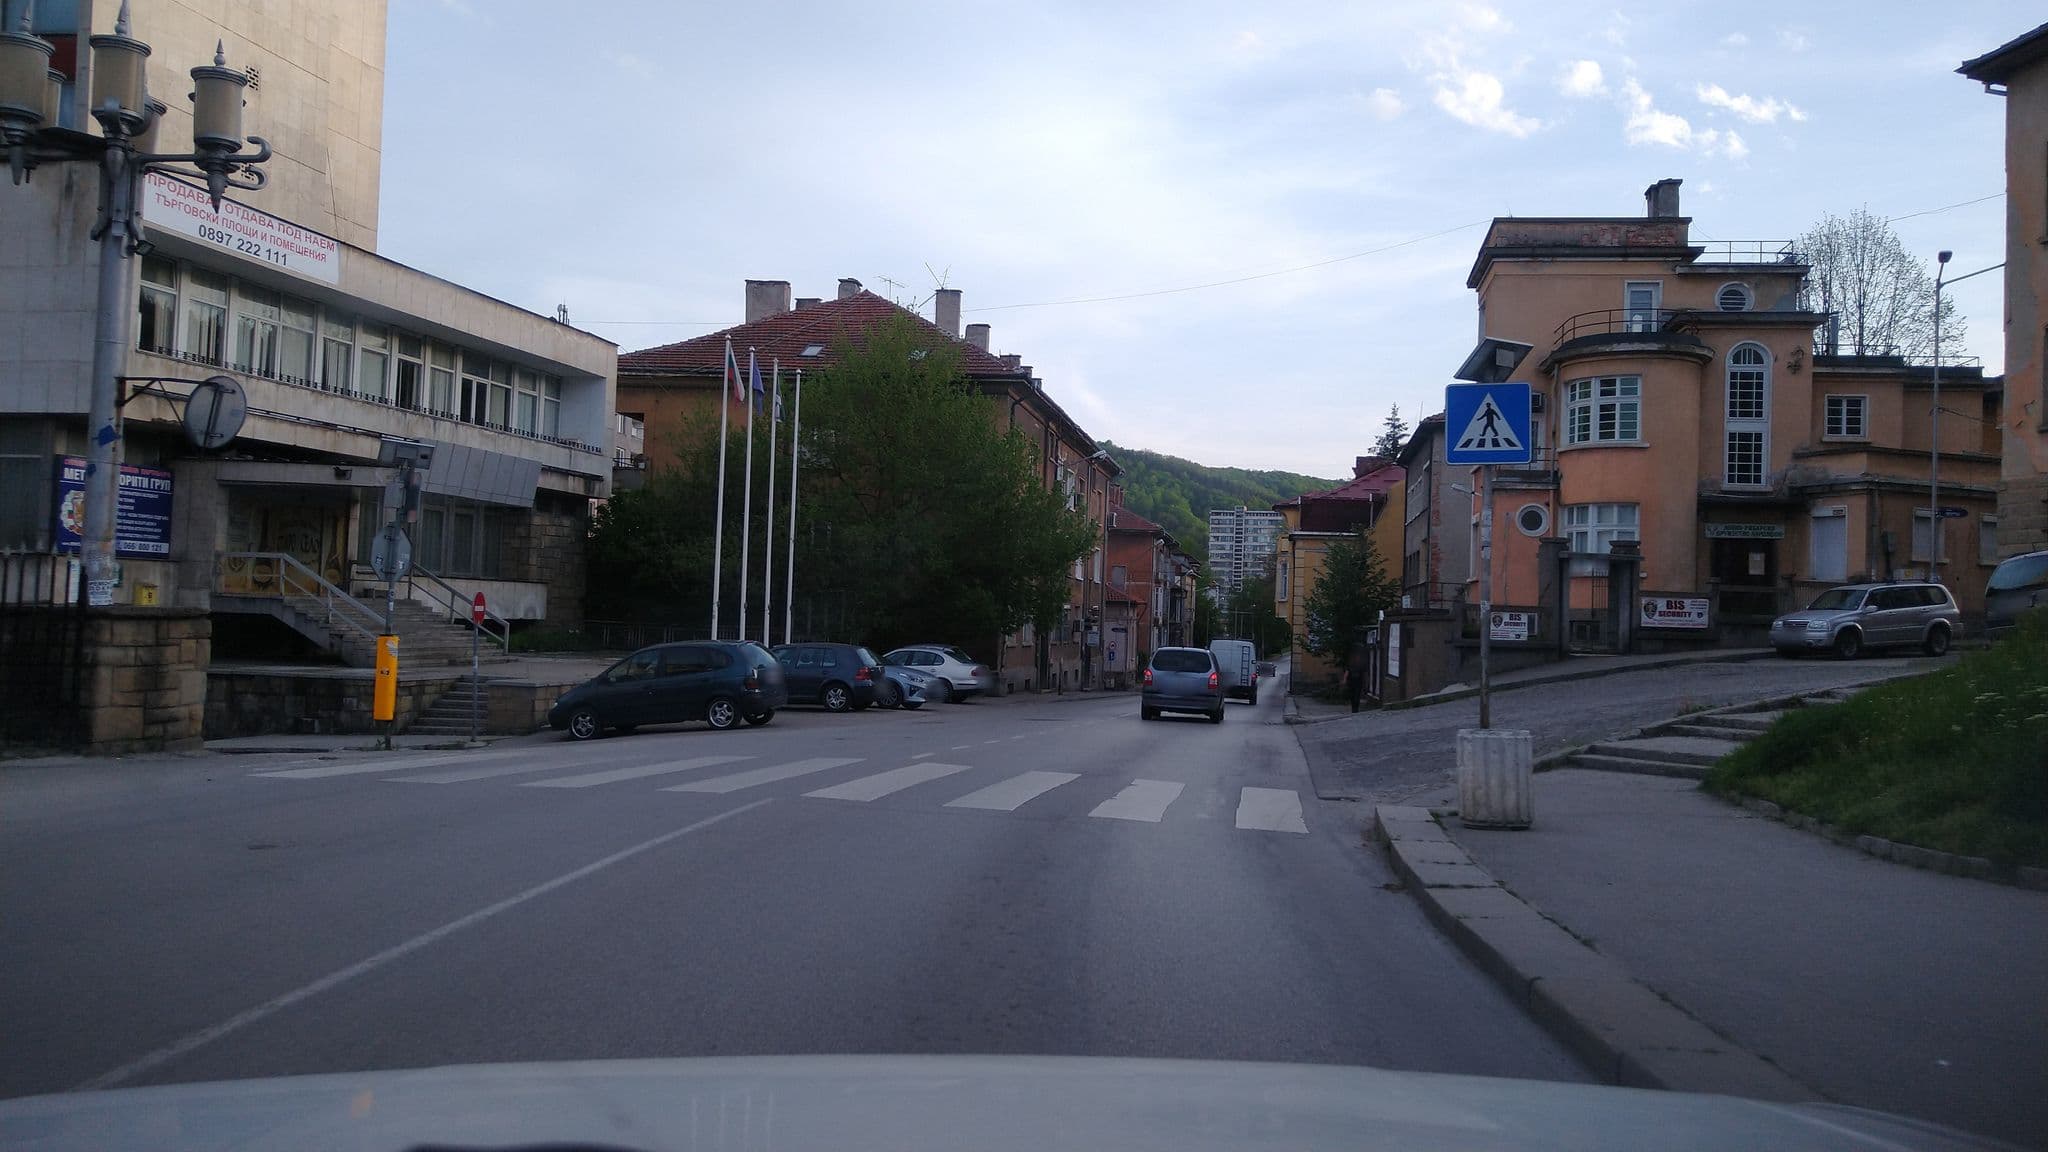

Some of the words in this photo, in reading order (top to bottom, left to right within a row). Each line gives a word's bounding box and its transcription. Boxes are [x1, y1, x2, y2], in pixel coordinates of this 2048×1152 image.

[155, 192, 220, 225] ТЪРГОВСКИ
[221, 217, 259, 241] ПЛОЩИ
[260, 231, 269, 242] И
[269, 234, 327, 263] ПОМЕЩЕНИЯ
[224, 202, 274, 230] ОТДАВА
[277, 222, 301, 240] ПОД
[304, 231, 336, 253] НАЕМ
[198, 223, 233, 247] 0897
[236, 238, 261, 257] 222
[265, 249, 288, 267] 111
[1508, 613, 1522, 621] BIS
[1657, 610, 1693, 618] SECURITY
[1666, 600, 1685, 610] BIS
